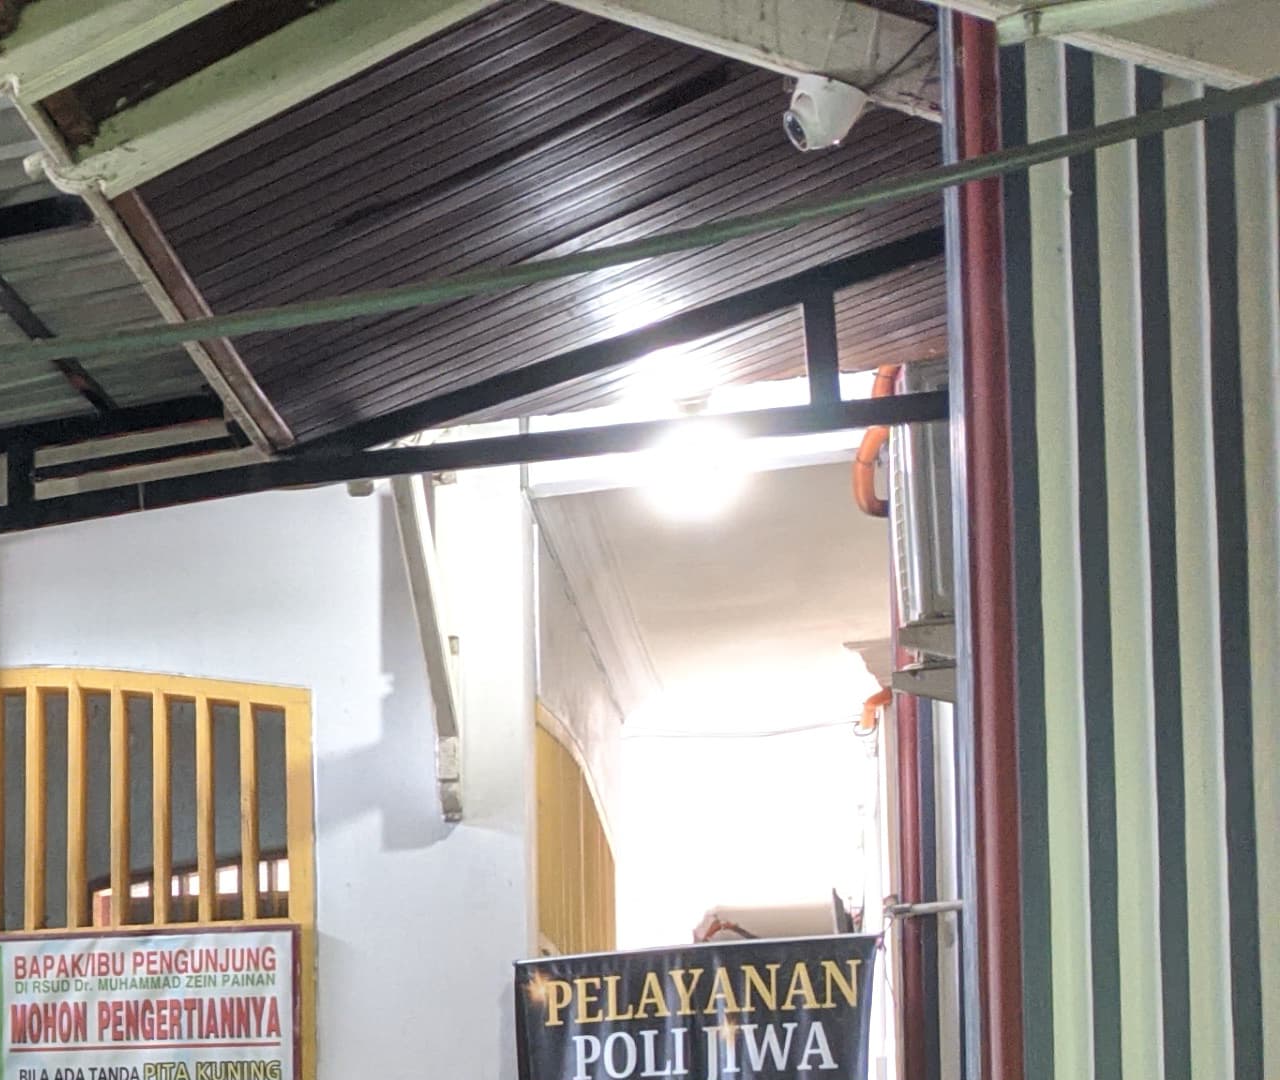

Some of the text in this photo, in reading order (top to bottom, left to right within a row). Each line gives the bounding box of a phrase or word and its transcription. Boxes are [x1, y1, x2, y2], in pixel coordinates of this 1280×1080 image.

[13, 946, 277, 980] BAPAK/IBU PENGUNJUNG
[15, 972, 276, 994] DI RSUD Dr. MUHAMMAD ZEIN PAINAN
[544, 959, 862, 1027] PELAYANAN
[11, 996, 282, 1044] MOHON PENGERTIANNYA
